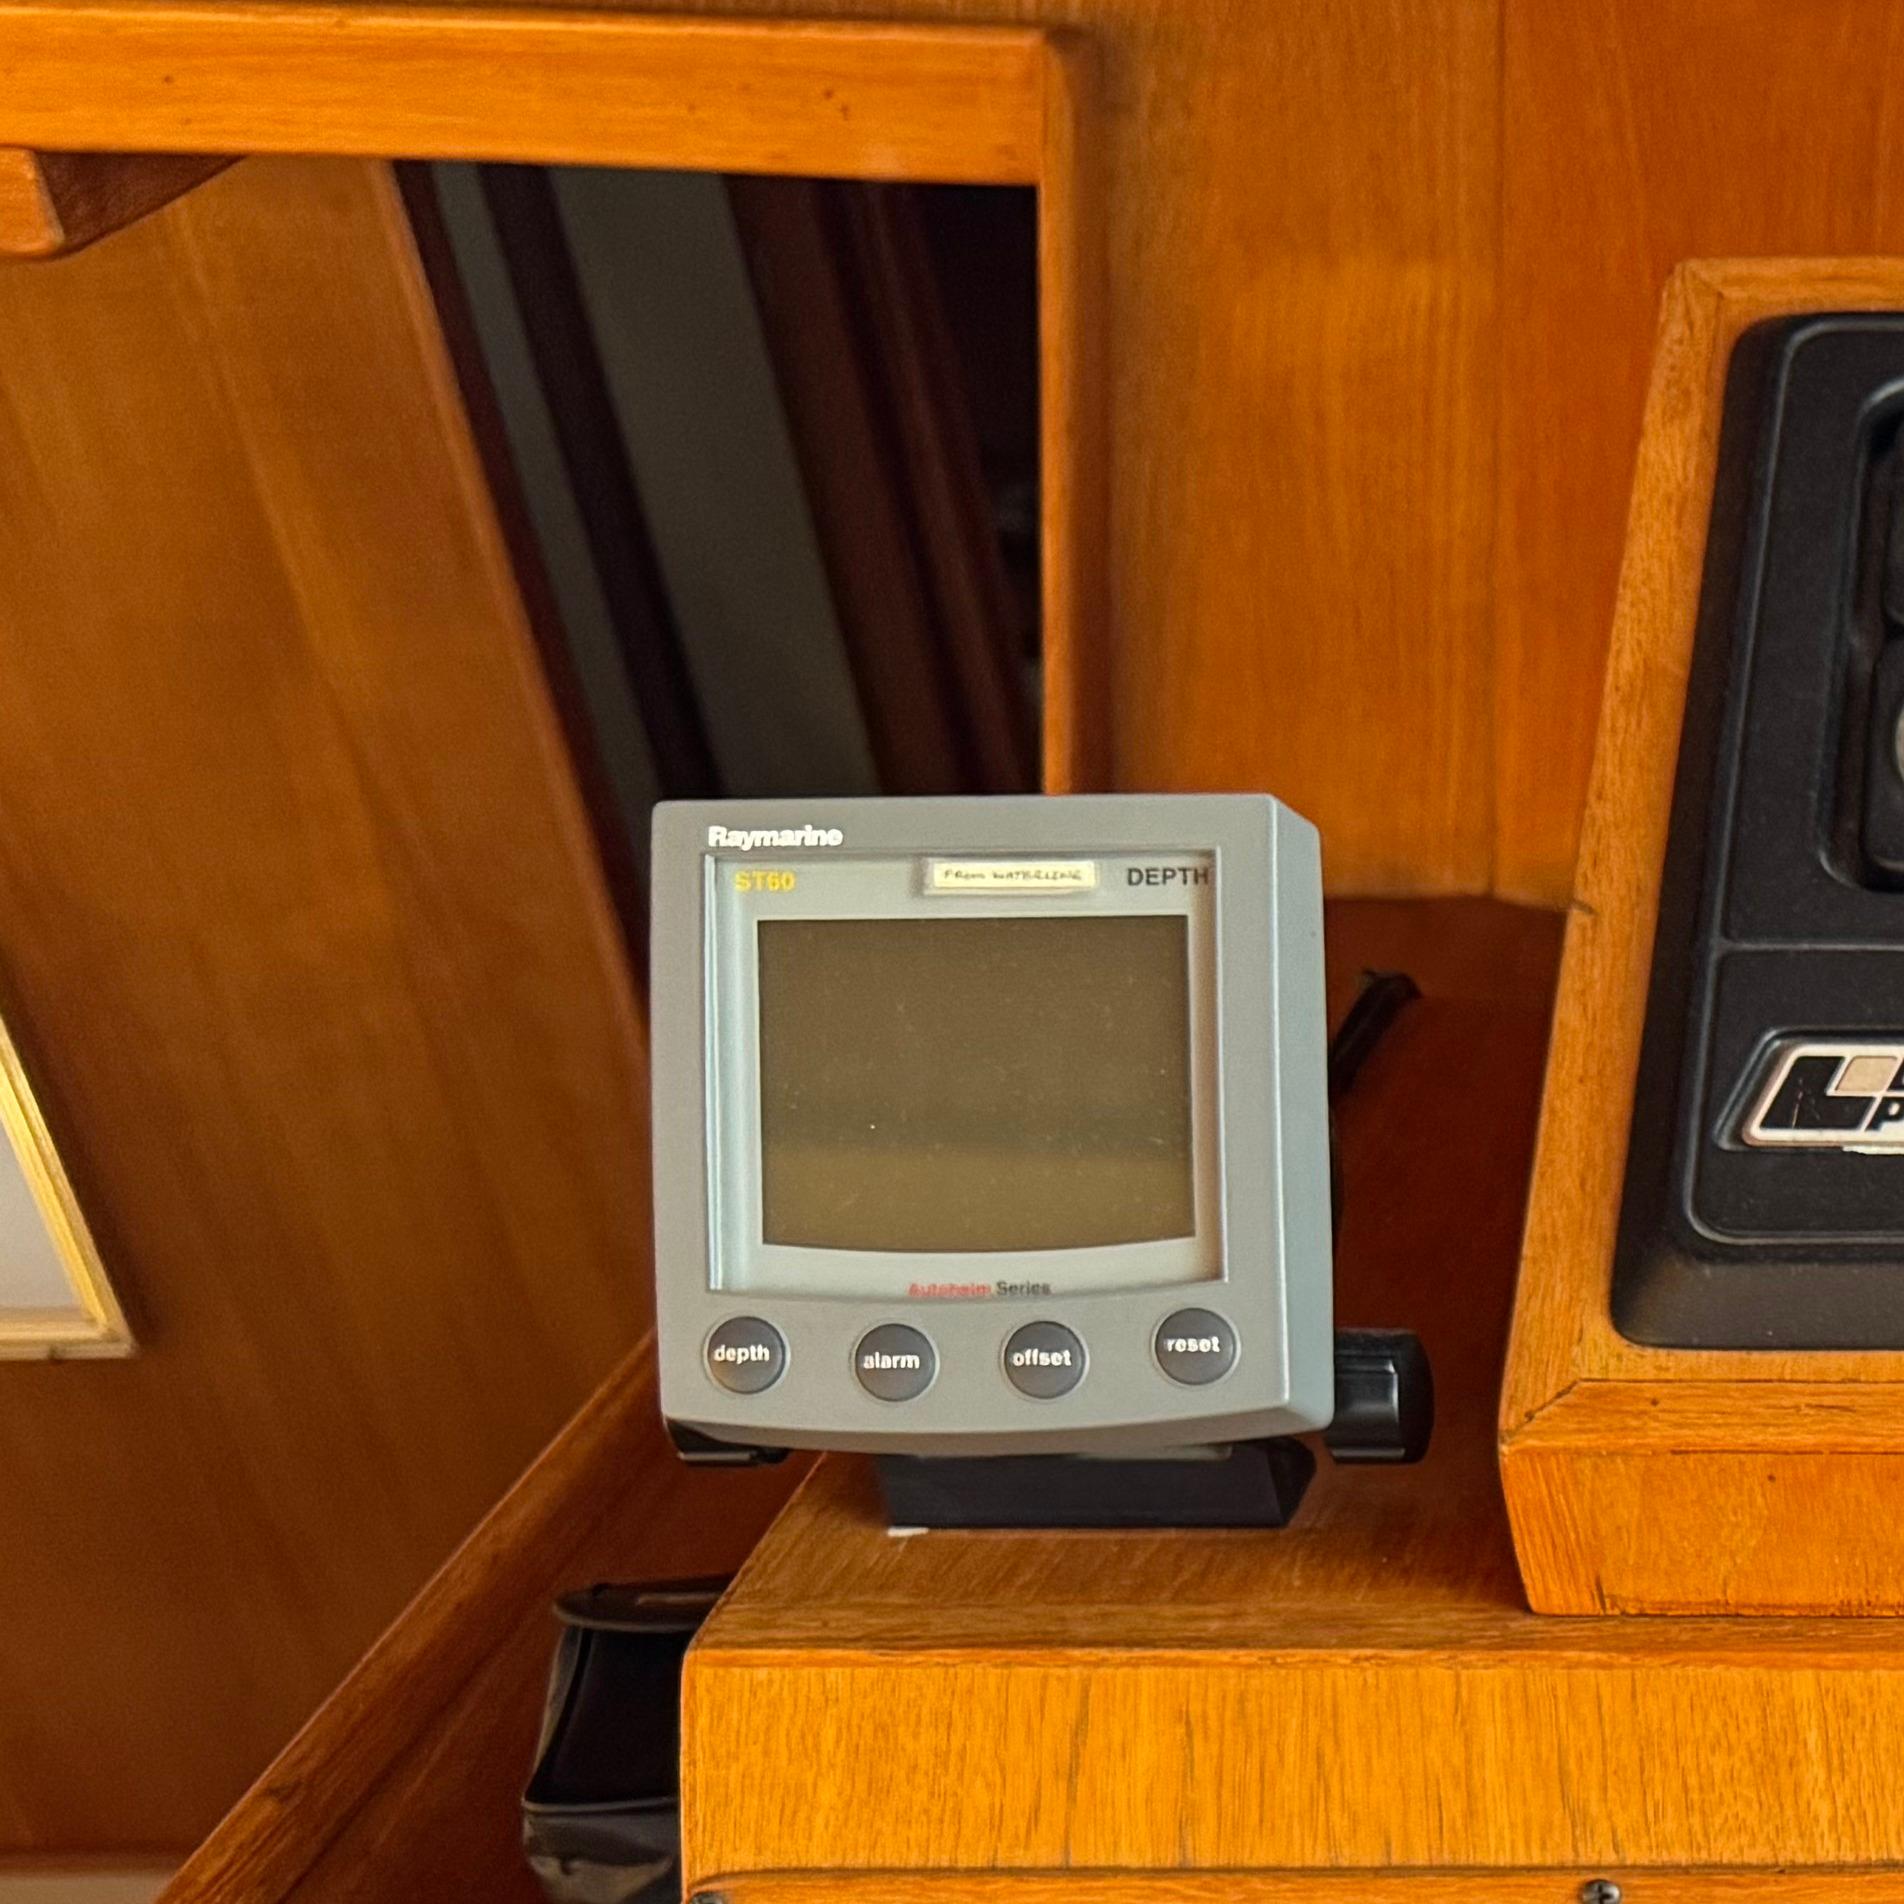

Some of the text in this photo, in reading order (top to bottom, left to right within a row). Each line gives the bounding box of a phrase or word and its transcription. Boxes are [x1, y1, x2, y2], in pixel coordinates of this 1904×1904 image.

[708, 825, 843, 851] Raymarine
[734, 870, 794, 892] ST60
[1126, 867, 1210, 887] DEPTH
[1166, 1335, 1220, 1354] reset
[713, 1344, 770, 1367] depth
[863, 1352, 920, 1370] alarm
[1012, 1348, 1071, 1368] offset
